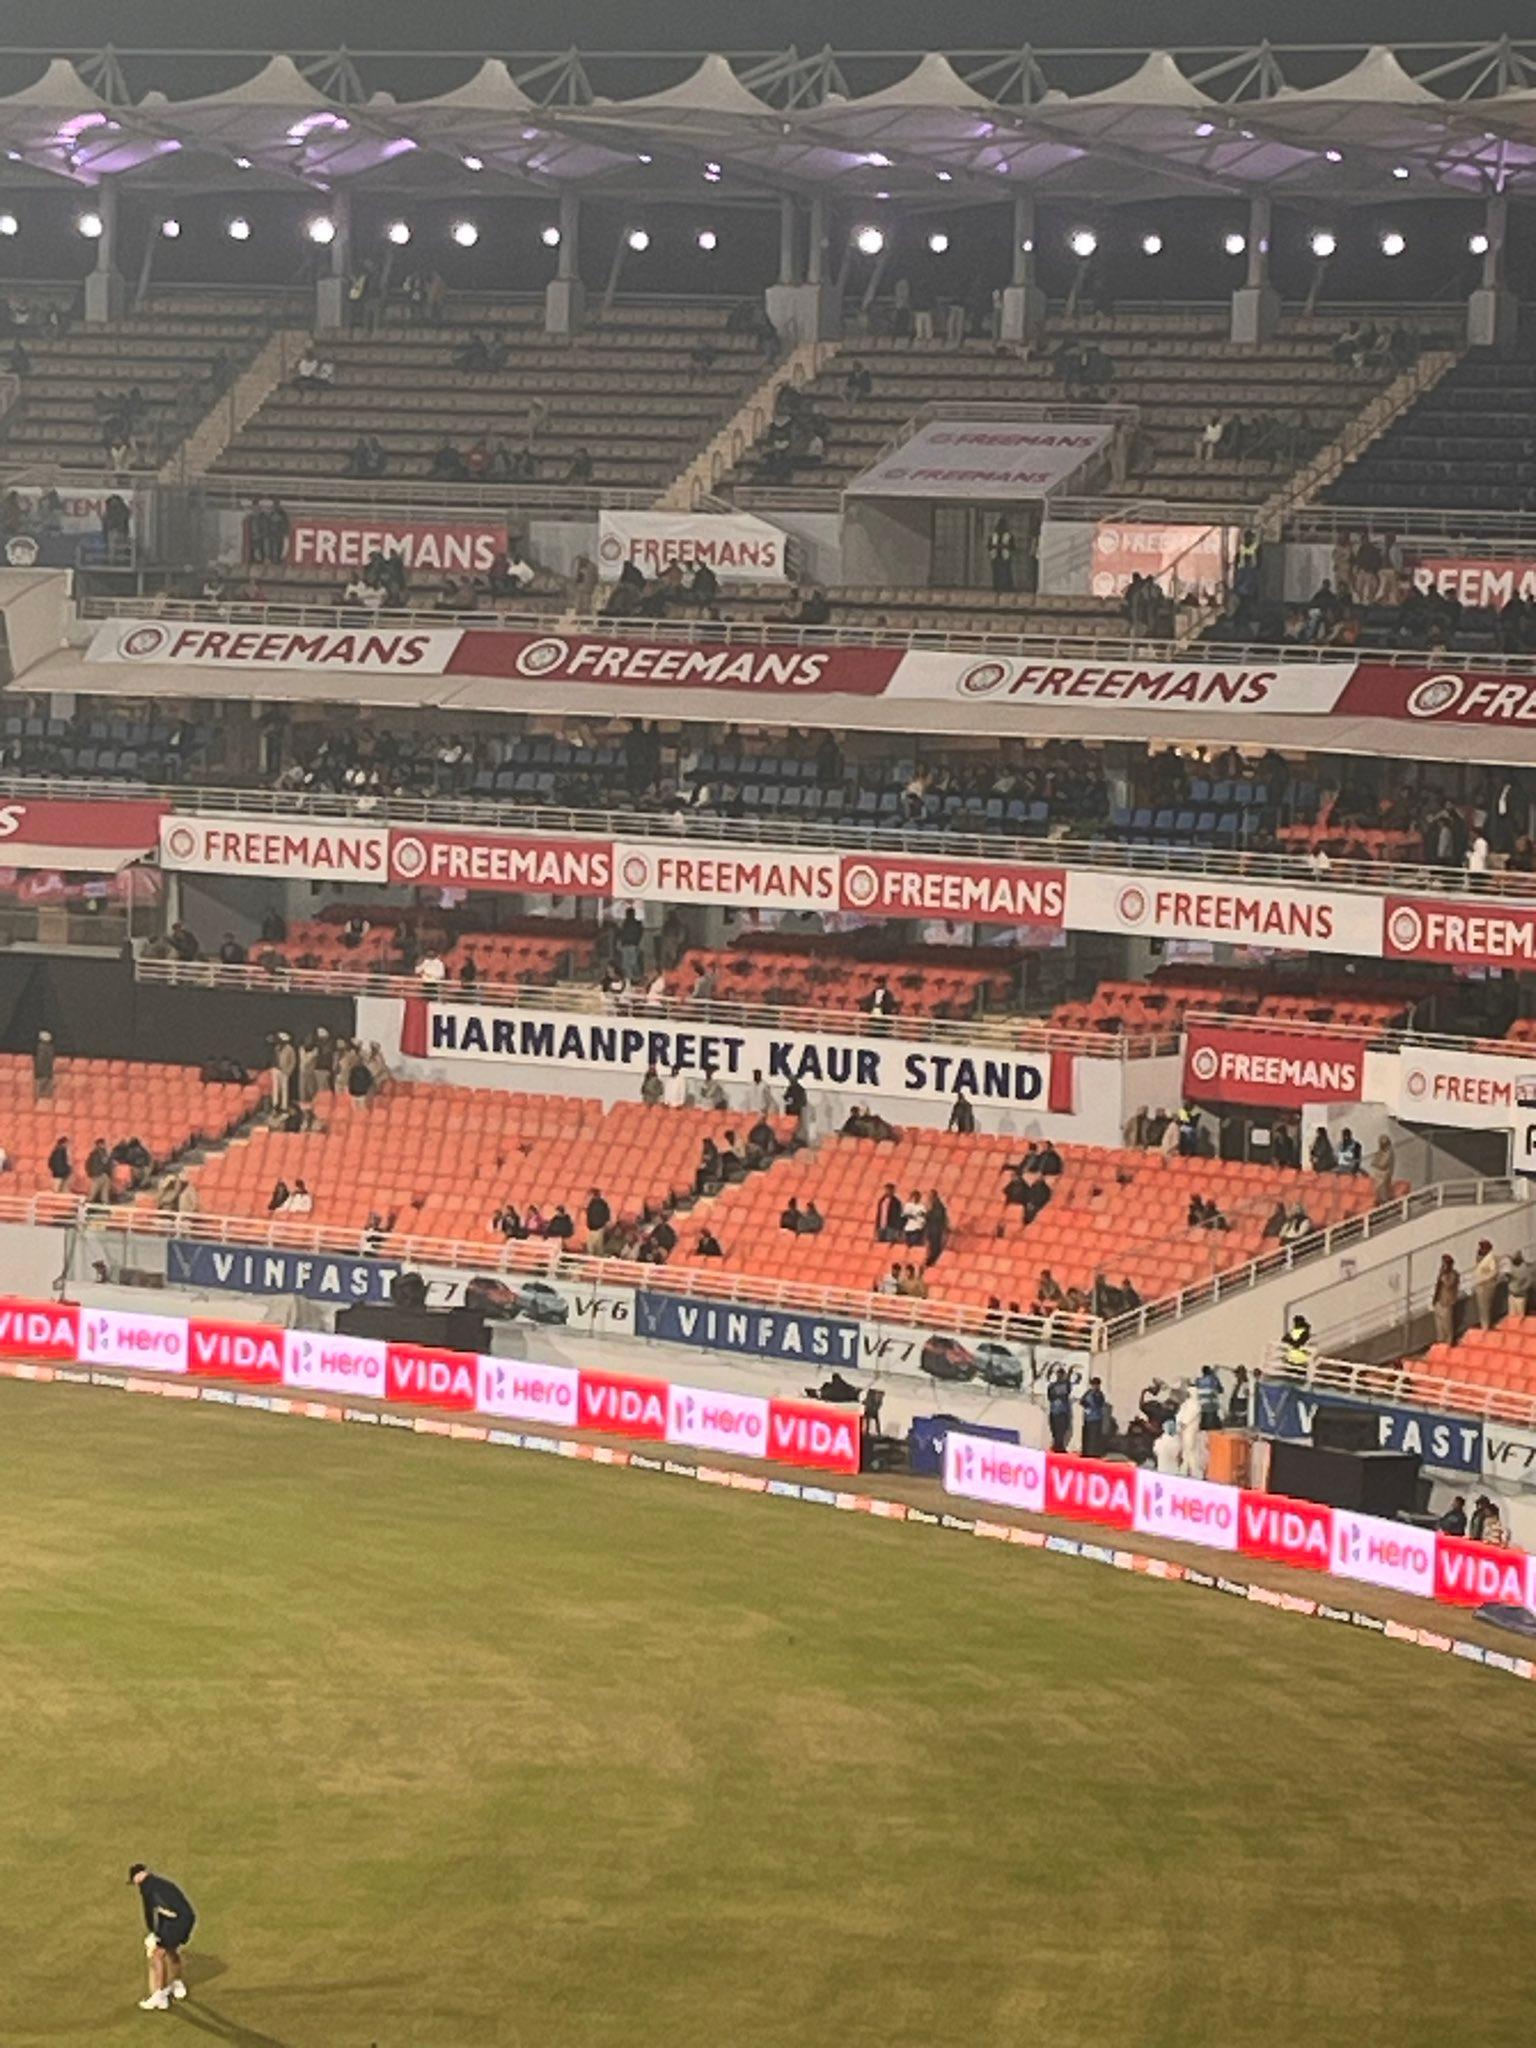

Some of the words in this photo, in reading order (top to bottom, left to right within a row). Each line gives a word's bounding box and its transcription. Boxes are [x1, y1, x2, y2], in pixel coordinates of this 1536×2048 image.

[629, 538, 777, 568] FREEMANS
[169, 630, 431, 665] FREEMANS
[567, 643, 829, 686] FREEMANS
[1007, 666, 1277, 703] FREEMANS
[204, 830, 382, 872] FREEMANS
[430, 844, 609, 887] FREEMANS
[657, 858, 834, 899] FREEMANS
[883, 872, 1064, 917] FREEMANS
[1155, 891, 1333, 939] FREEMANS
[1426, 913, 1536, 958] FREEM
[432, 1014, 745, 1074] HARMANPREET
[769, 1042, 881, 1087] KAUR
[905, 1053, 1043, 1101] STAND
[1220, 1053, 1355, 1092] FREEMANS
[213, 1253, 397, 1297] VINFAST
[117, 1326, 180, 1355] Hero
[195, 1332, 281, 1370] VIDA
[678, 1306, 858, 1359] VINFAST
[863, 1335, 917, 1363] VF7
[321, 1344, 380, 1379] Hero
[390, 1356, 474, 1396] VIDA
[513, 1372, 571, 1408] Hero
[585, 1383, 667, 1424] VIDA
[701, 1408, 762, 1437] Hero
[773, 1415, 853, 1458] VIDA
[1297, 1401, 1479, 1463] VFAST
[981, 1455, 1039, 1491] Hero
[1051, 1468, 1131, 1513] VIDA
[1170, 1493, 1231, 1530] Hero
[1245, 1507, 1327, 1553] VIDA
[1368, 1535, 1429, 1575] Hero
[1442, 1550, 1524, 1604] VIDA
